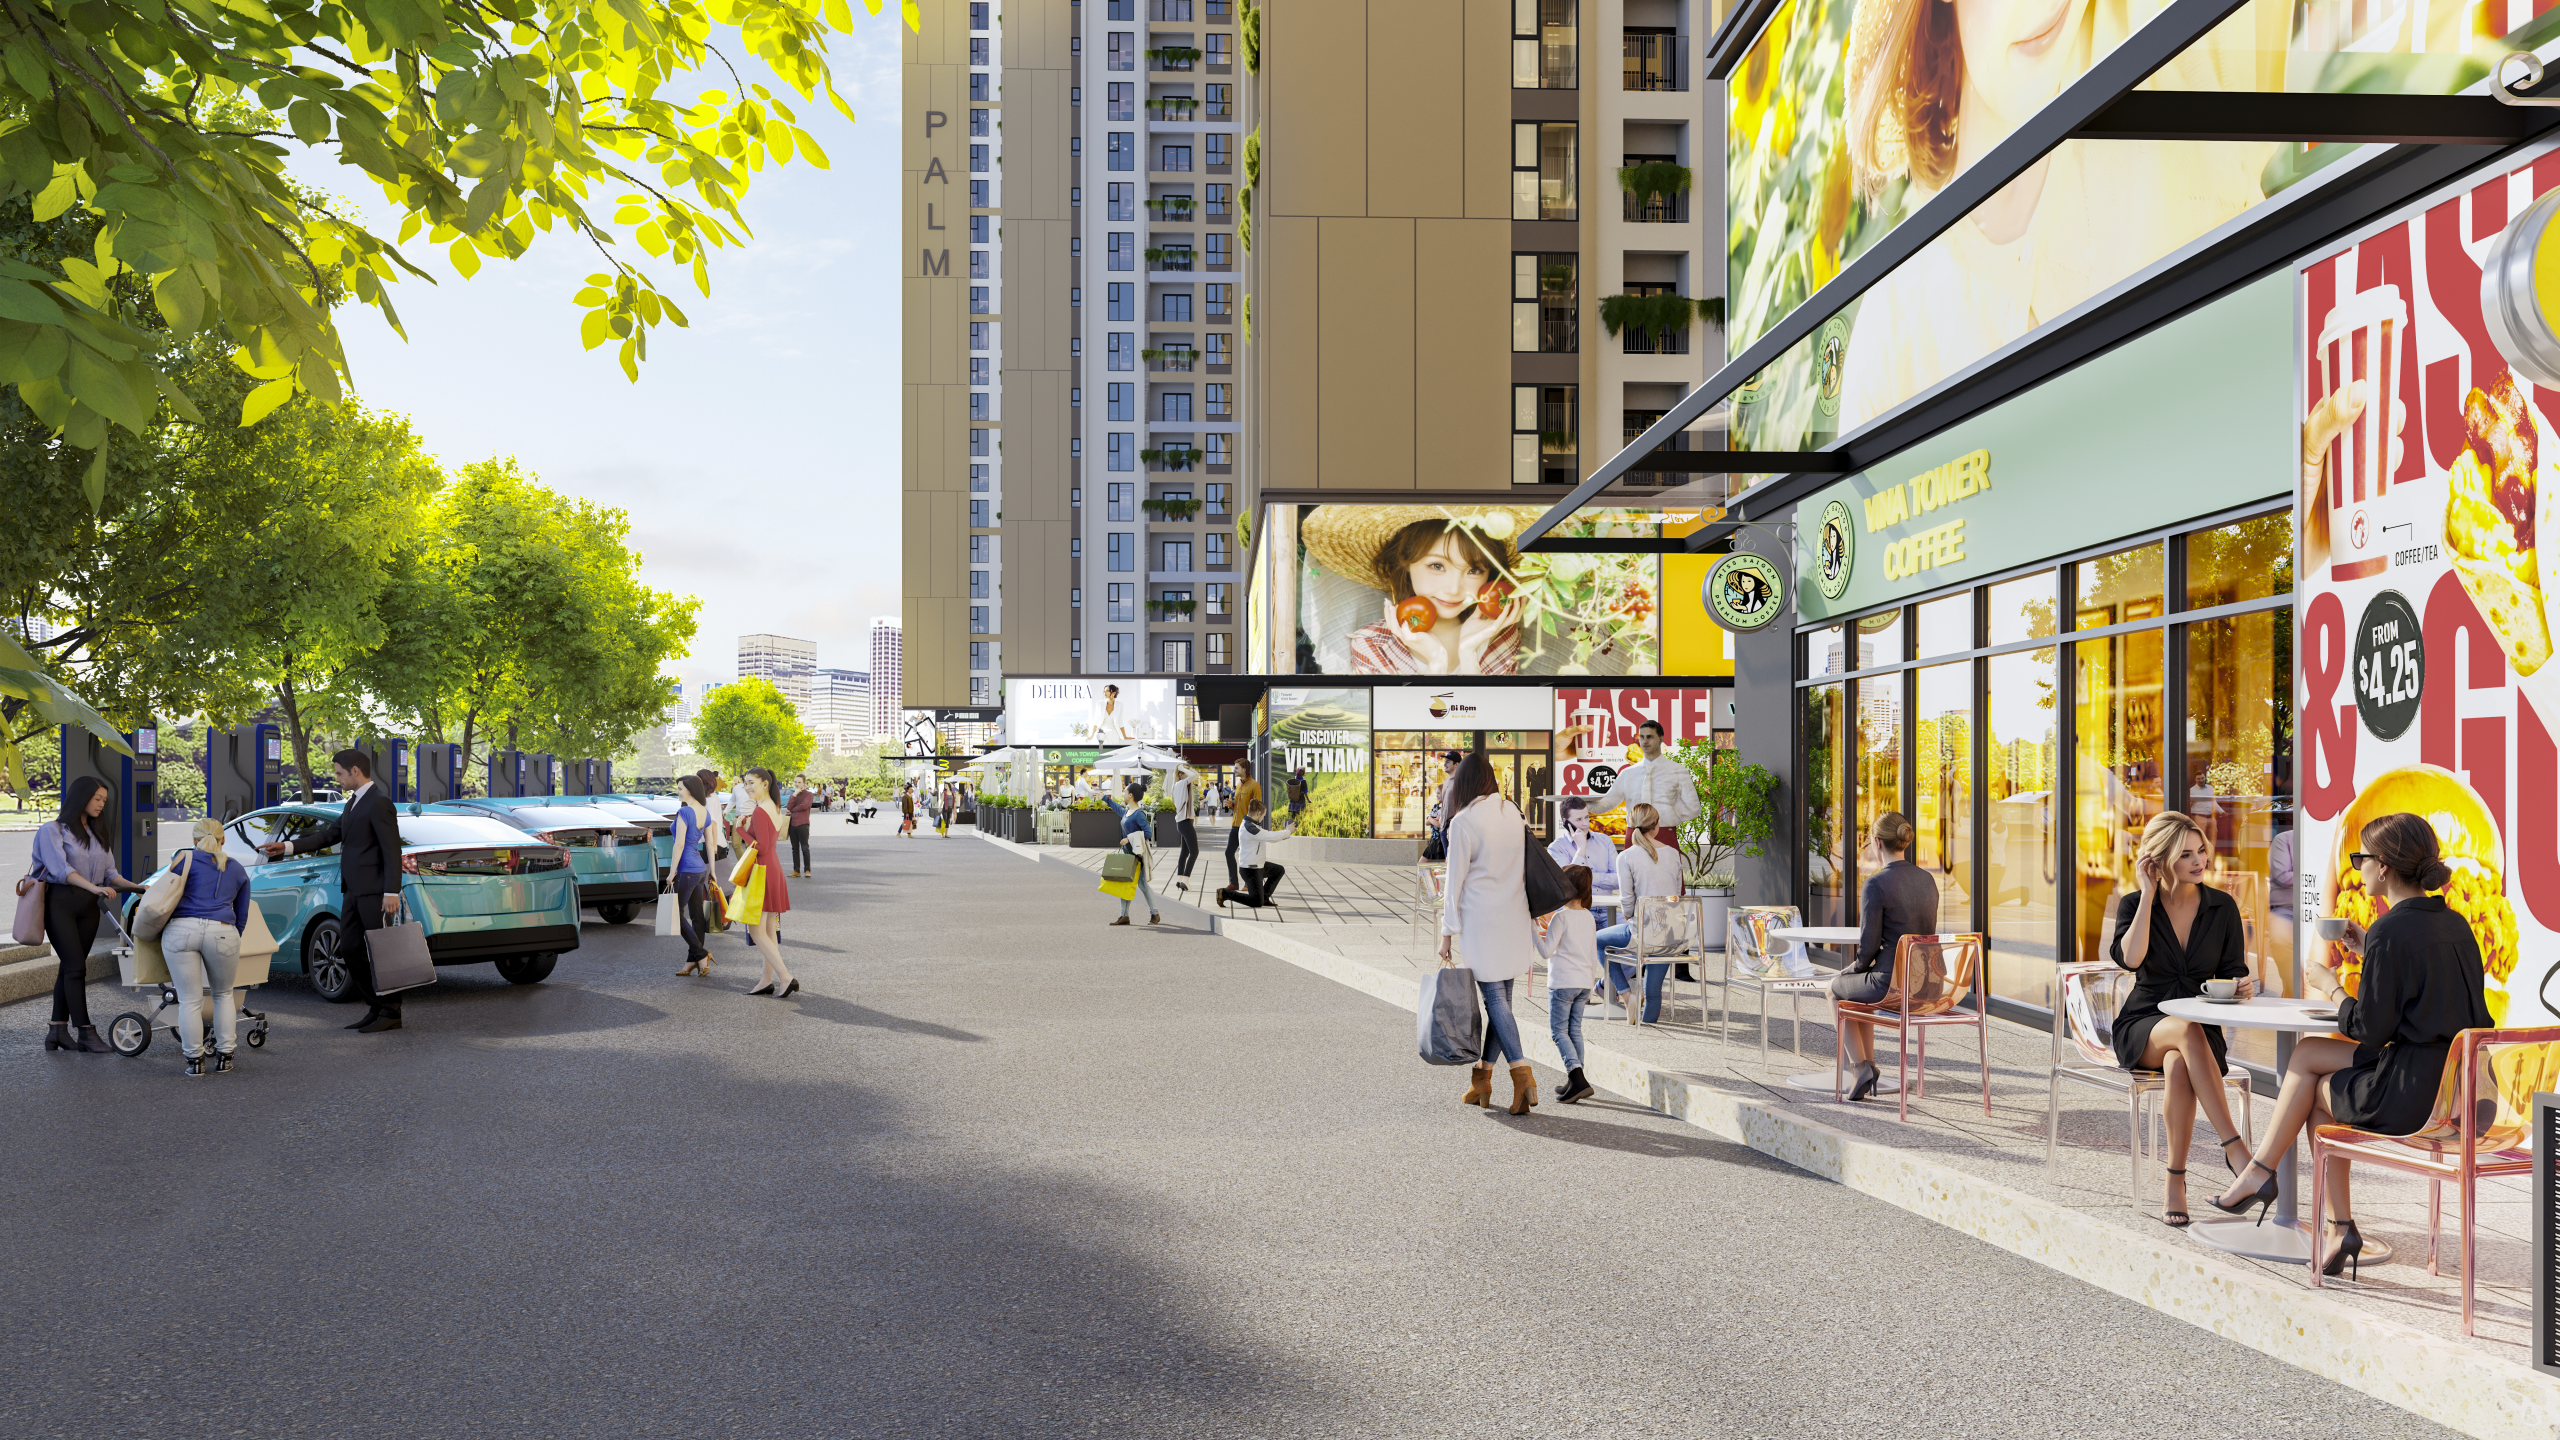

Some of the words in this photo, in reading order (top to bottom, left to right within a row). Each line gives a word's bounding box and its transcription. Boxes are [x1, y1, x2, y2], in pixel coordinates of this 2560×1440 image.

[922, 111, 950, 276] PALM
[1908, 448, 1992, 516] TOWER
[1883, 518, 1966, 581] COFFEE
[2395, 544, 2439, 567] COFFEE/TEA
[1717, 560, 1737, 579] MISS
[1742, 557, 1777, 580] SAIGON
[1715, 594, 1748, 624] PREMIUM
[1753, 595, 1779, 623] COFFEE
[2372, 619, 2399, 647] FROM
[2359, 639, 2419, 708] $4.25
[1032, 684, 1093, 699] DEHURA
[1557, 689, 1708, 747] TASTE
[1300, 730, 1350, 745] DISCOVER
[1284, 748, 1364, 773] VIETNAM
